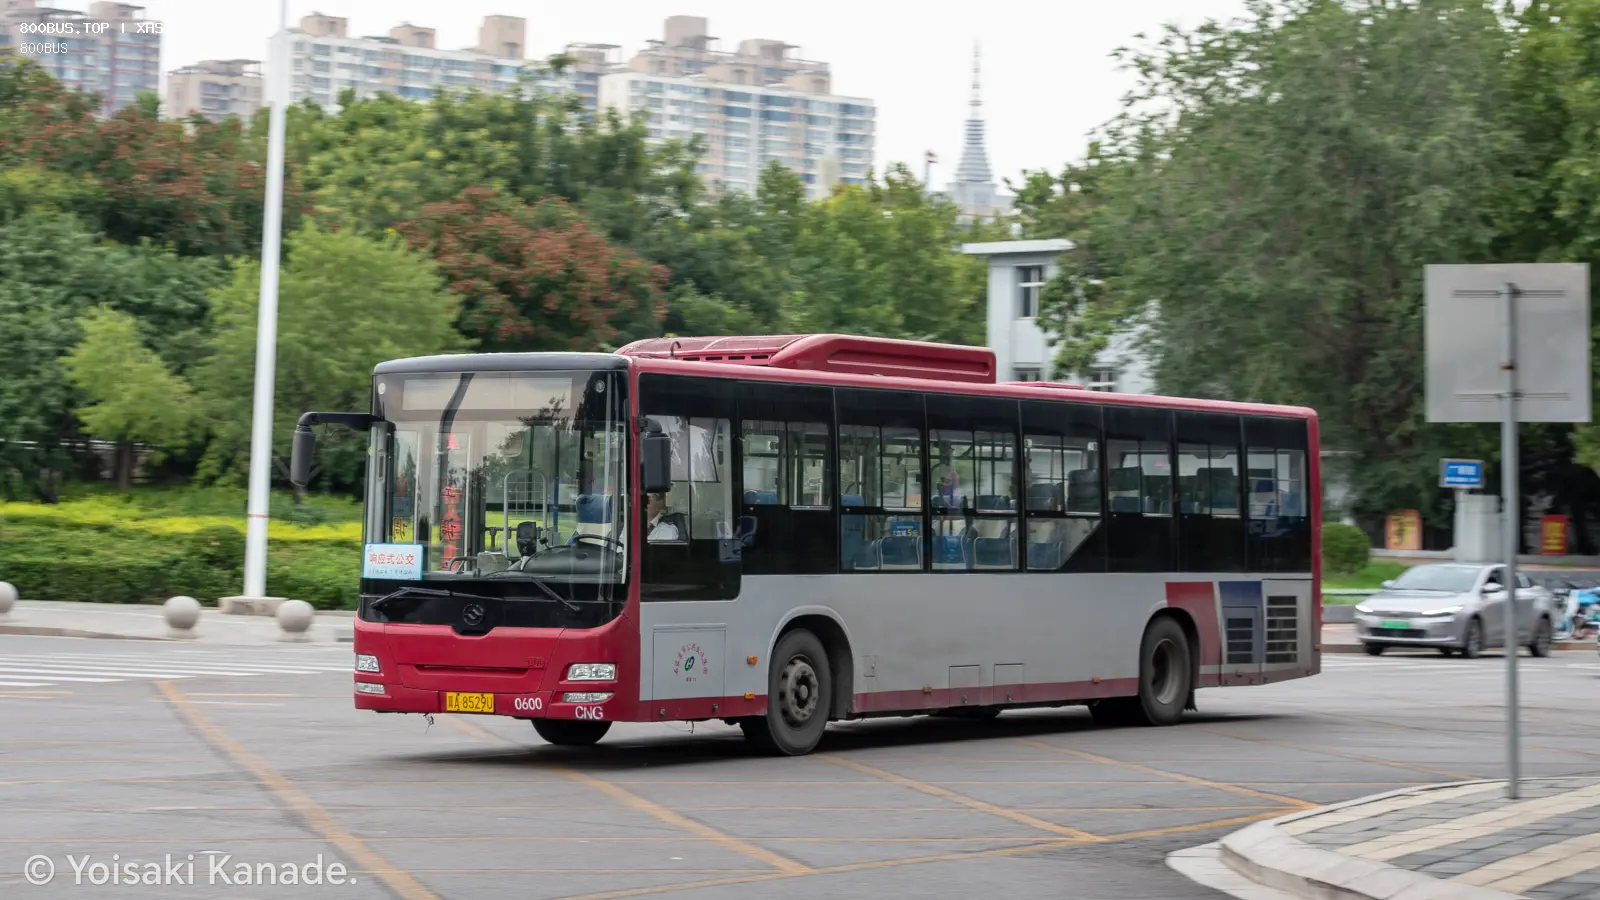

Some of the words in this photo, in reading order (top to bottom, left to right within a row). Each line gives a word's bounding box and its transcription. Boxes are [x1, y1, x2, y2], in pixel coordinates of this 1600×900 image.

[369, 553, 415, 566] 响应式公交
[514, 697, 543, 711] 0600
[575, 705, 604, 720] CNG
